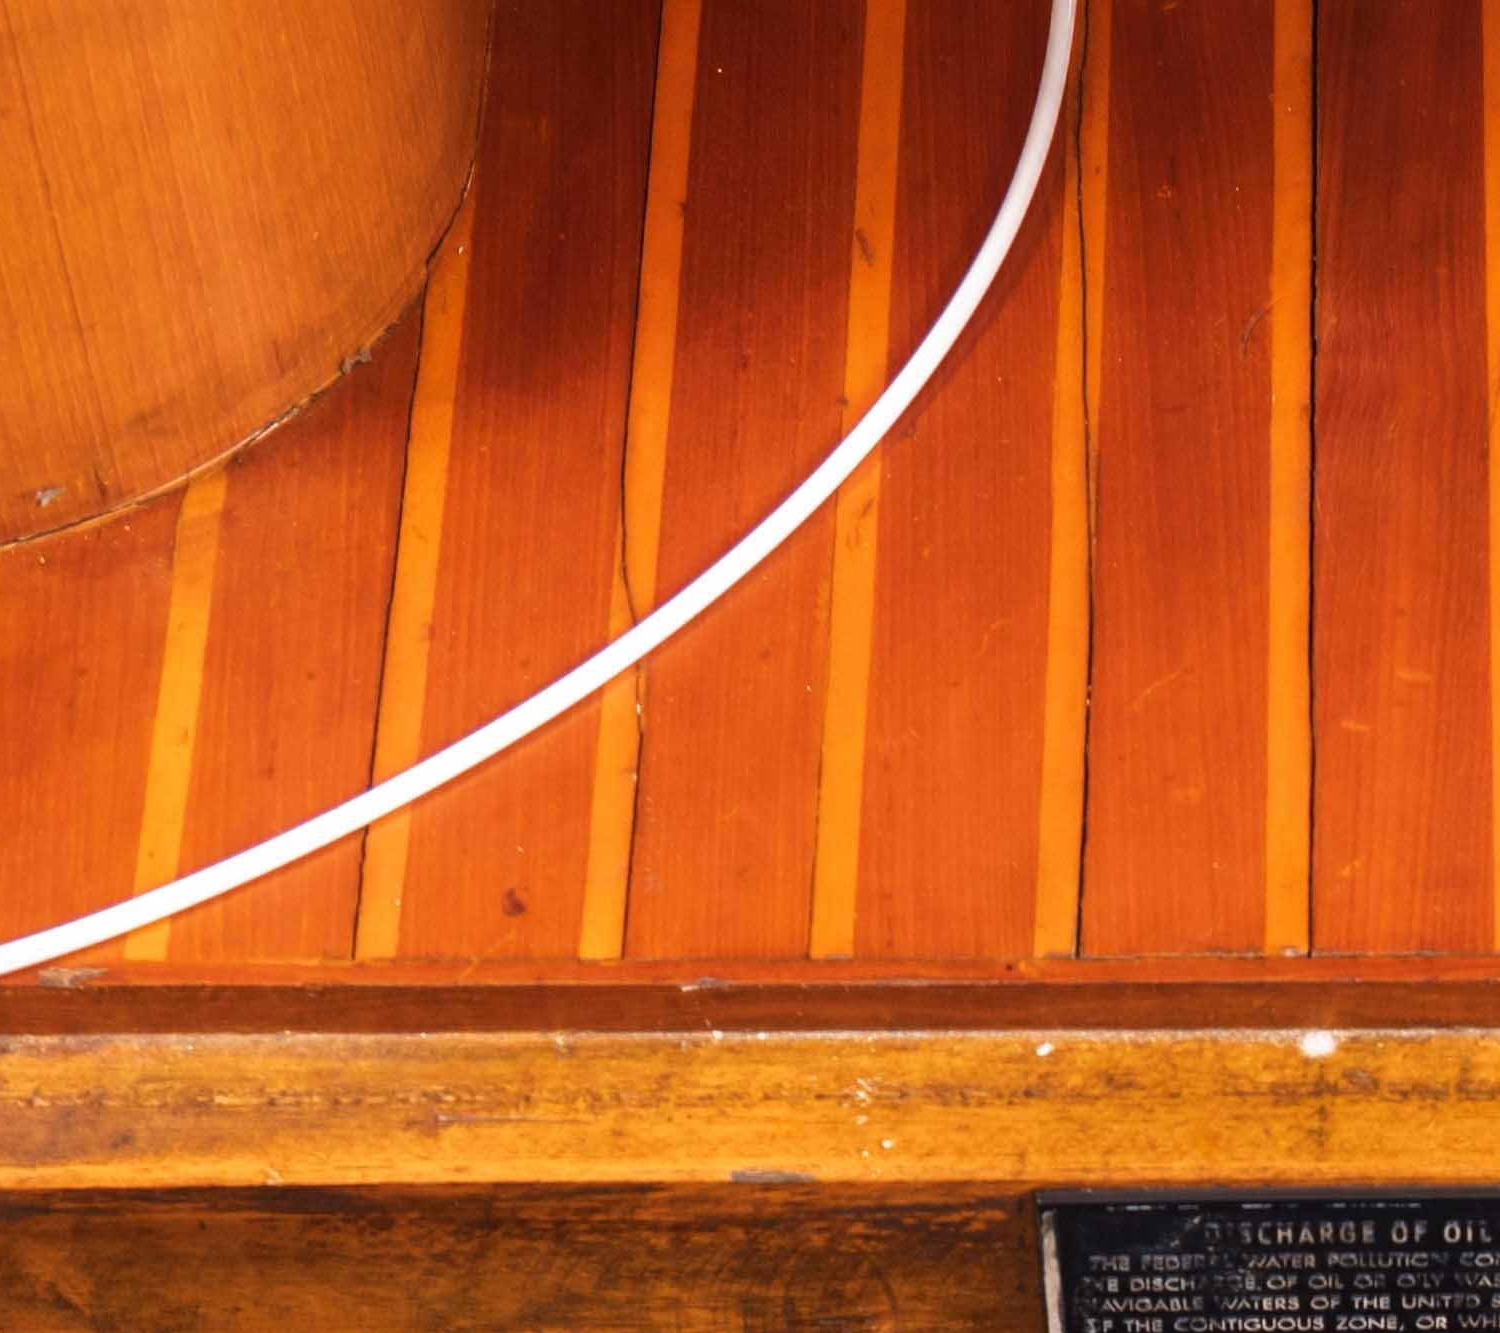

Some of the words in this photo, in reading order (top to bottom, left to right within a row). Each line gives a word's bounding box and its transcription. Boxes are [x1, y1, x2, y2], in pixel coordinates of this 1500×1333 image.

[1390, 1219, 1428, 1243] OF
[1443, 1219, 1493, 1243] OIL
[1089, 1254, 1131, 1272] THE
[1243, 1253, 1317, 1269] WATER
[1266, 1274, 1299, 1290] OF
[1308, 1273, 1344, 1290] OIL
[1353, 1273, 1386, 1289] OR
[1080, 1296, 1205, 1313] AVIGABLE
[1215, 1295, 1300, 1311] WATERS
[1310, 1295, 1341, 1310] OF
[1352, 1295, 1391, 1310] THE
[1123, 1317, 1164, 1333] THE
[1173, 1316, 1325, 1332] CONTIGUOUS
[1335, 1315, 1405, 1332] ZONE,
[1415, 1315, 1448, 1331] OR
